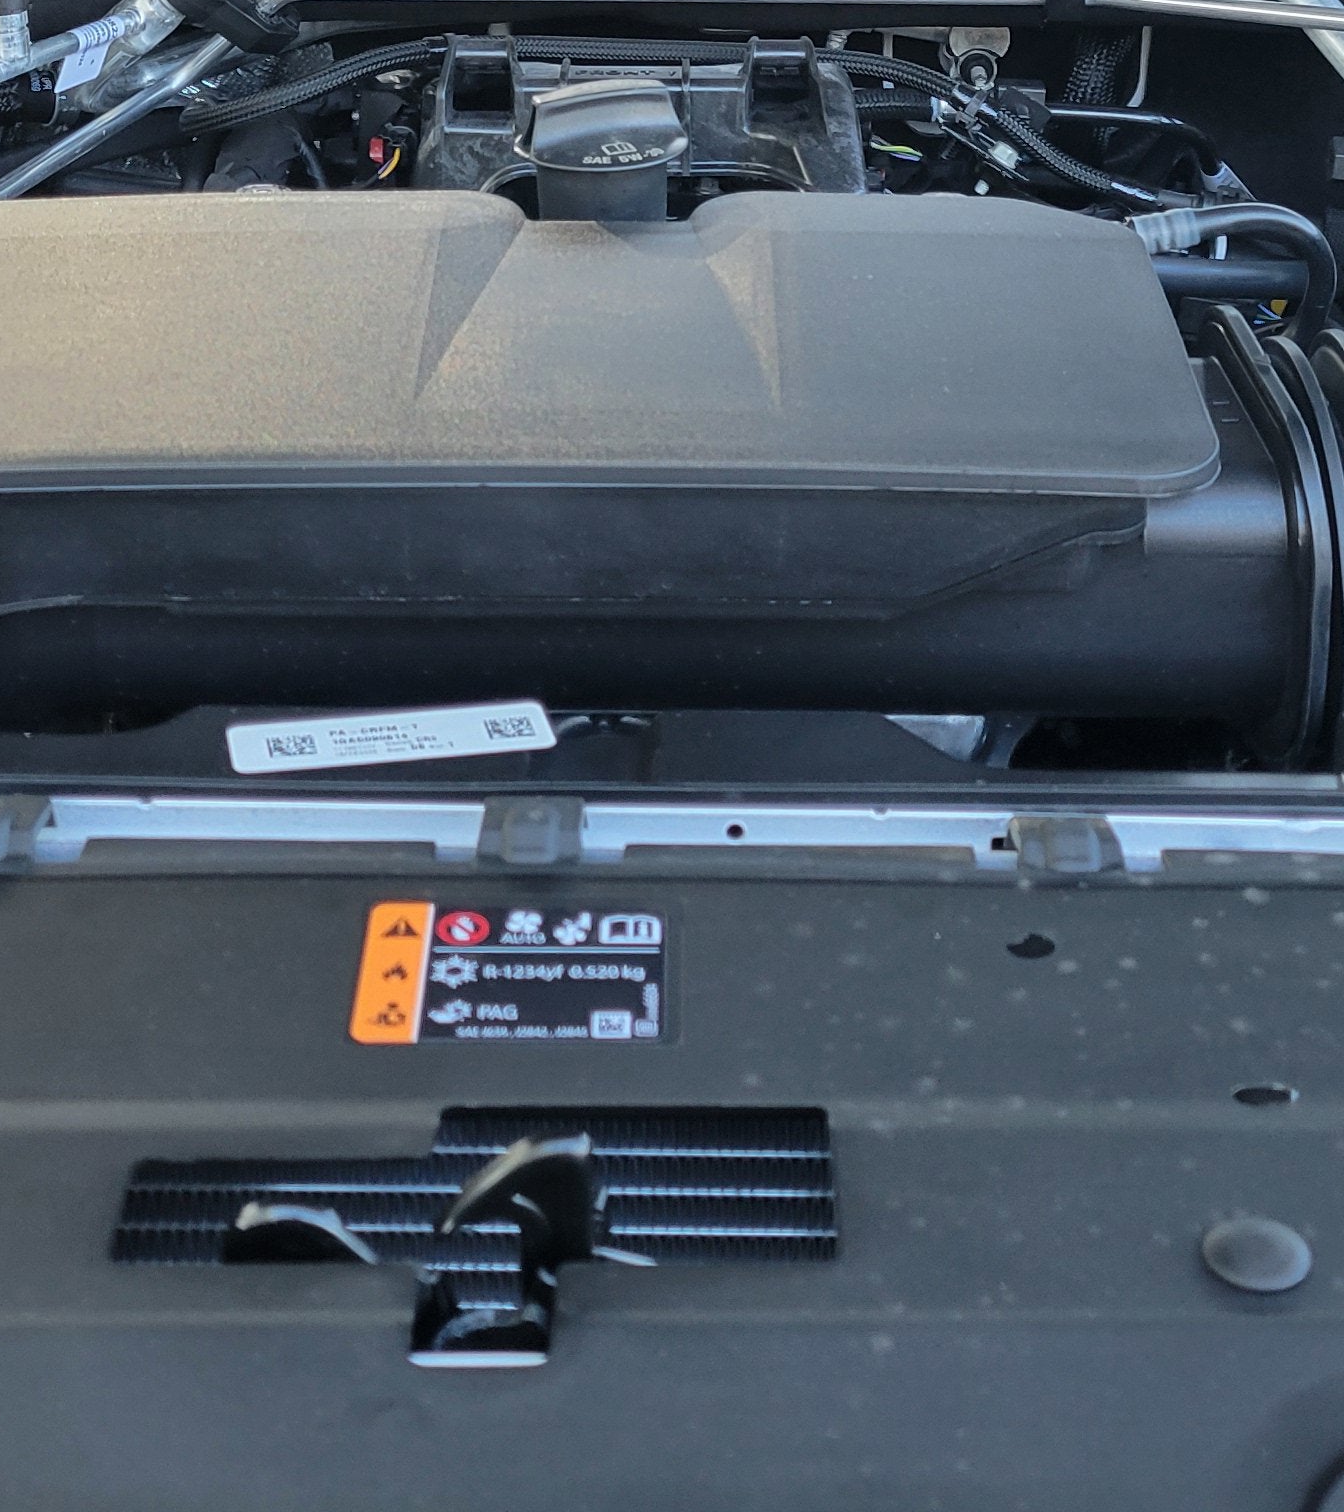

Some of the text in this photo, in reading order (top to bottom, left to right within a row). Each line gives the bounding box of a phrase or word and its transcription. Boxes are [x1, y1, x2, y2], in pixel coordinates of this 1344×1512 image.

[582, 156, 612, 165] SAE
[500, 932, 546, 945] AUTO
[482, 964, 564, 983] R-1234yf
[620, 964, 646, 983] kg
[476, 1003, 519, 1021] PAG
